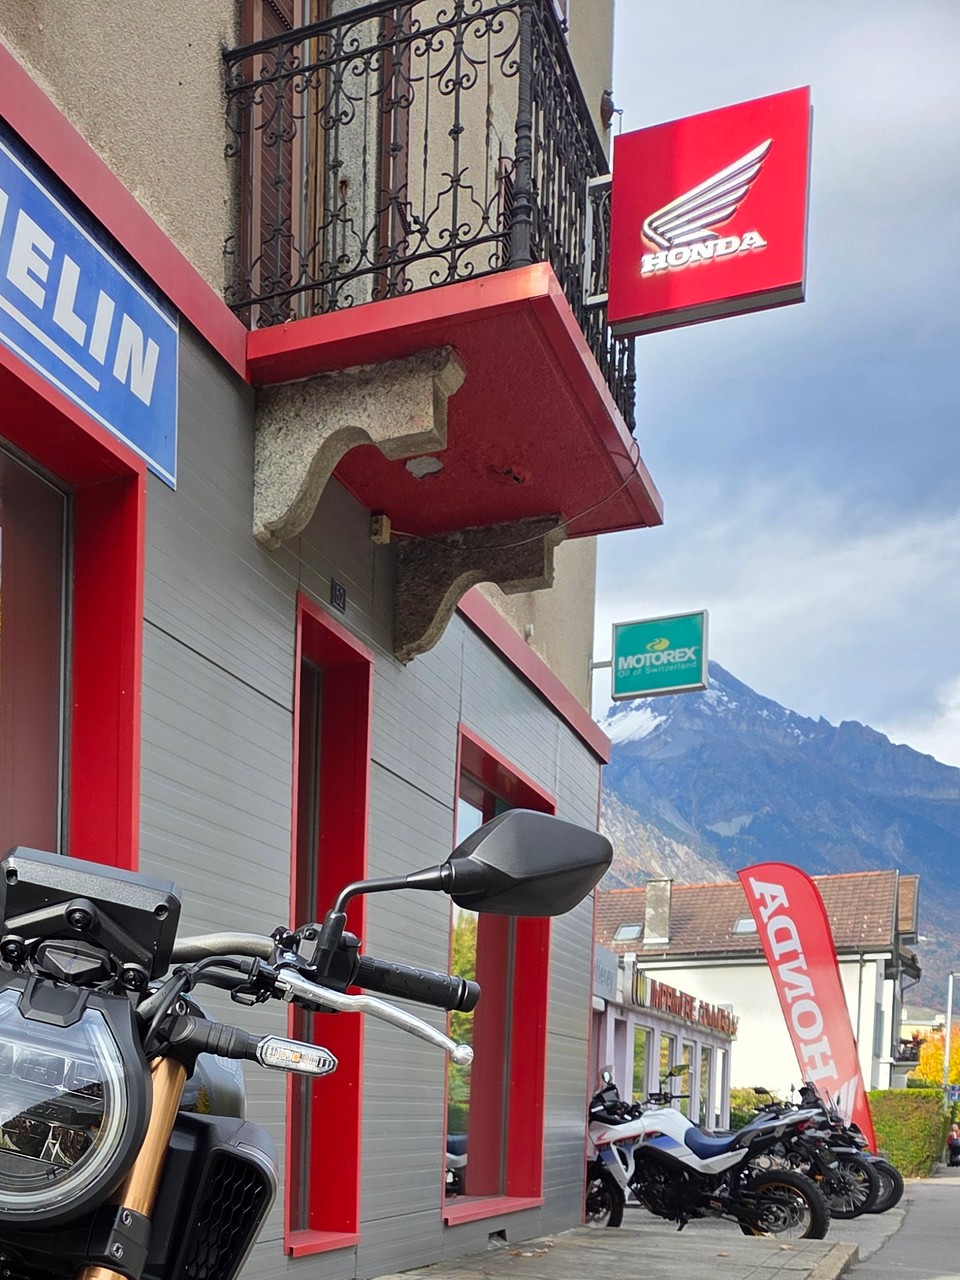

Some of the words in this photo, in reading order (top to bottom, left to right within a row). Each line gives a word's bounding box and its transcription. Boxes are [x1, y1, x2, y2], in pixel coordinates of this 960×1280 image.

[640, 230, 767, 274] HONDA
[617, 669, 631, 678] Oil
[633, 668, 642, 676] of
[646, 660, 697, 674] Switzerland
[618, 646, 697, 670] MOTOREX
